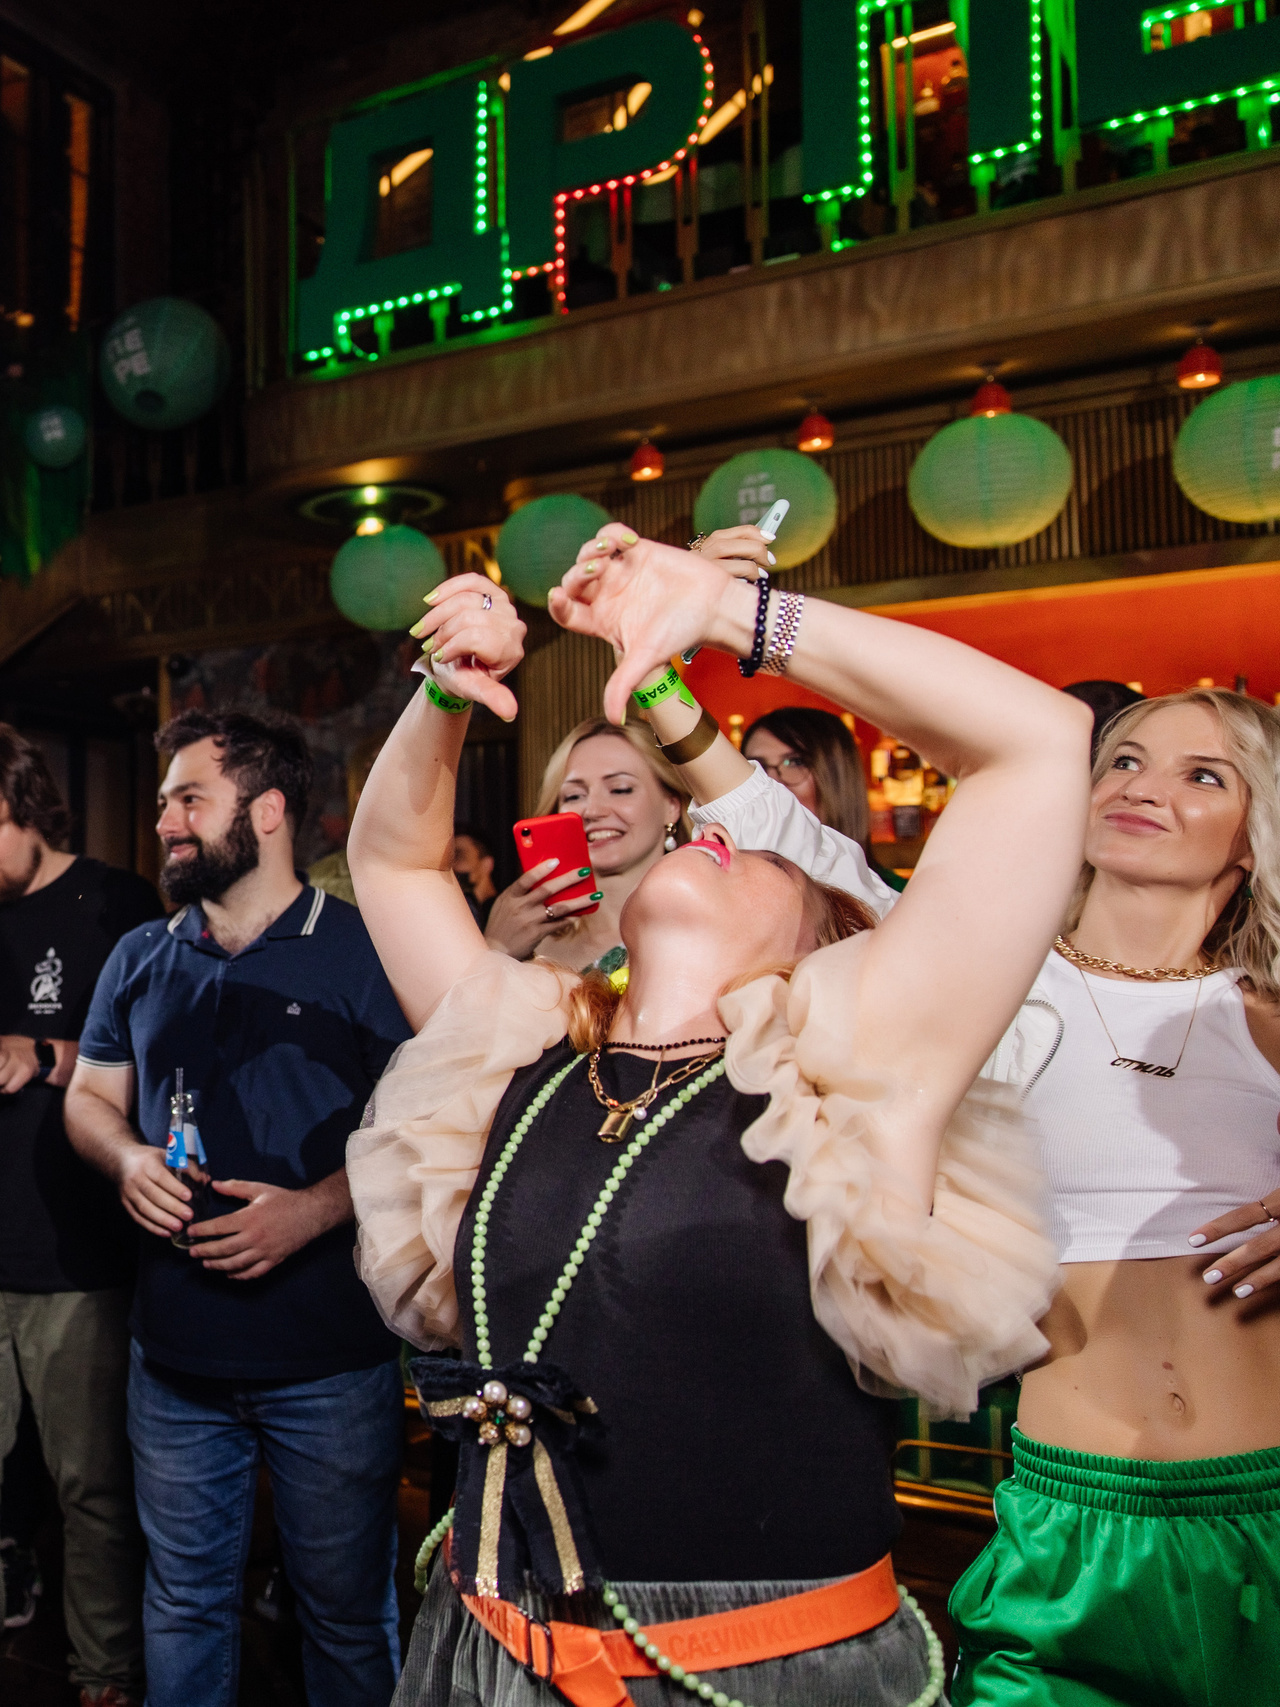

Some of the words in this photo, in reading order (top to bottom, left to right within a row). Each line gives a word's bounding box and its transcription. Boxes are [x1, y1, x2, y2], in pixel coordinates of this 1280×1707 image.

[637, 682, 668, 703] BAR
[668, 1618, 760, 1661] CALVIN
[762, 1604, 834, 1646] KLEIN
